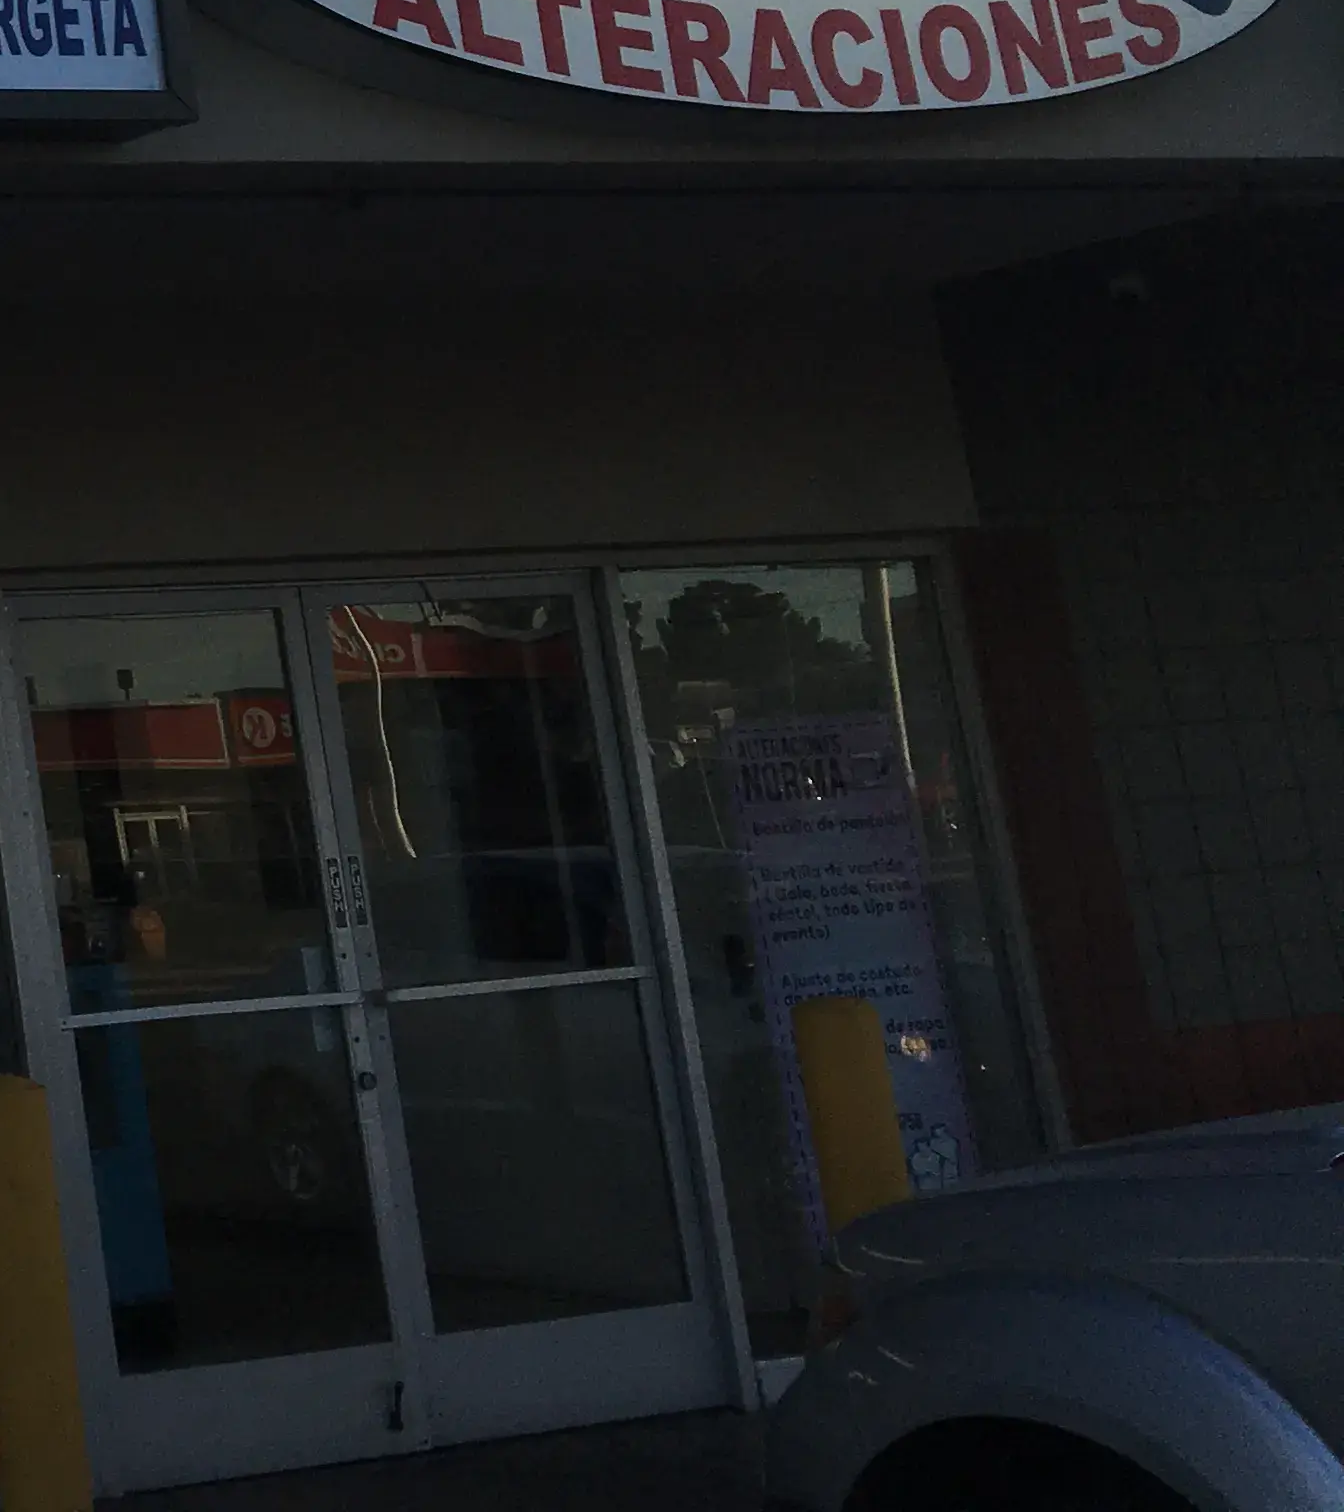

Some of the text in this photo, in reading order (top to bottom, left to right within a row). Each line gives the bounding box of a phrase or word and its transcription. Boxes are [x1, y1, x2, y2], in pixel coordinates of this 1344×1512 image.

[740, 757, 848, 802] NORMA
[328, 866, 345, 912] PUSH
[349, 863, 366, 910] PUSH
